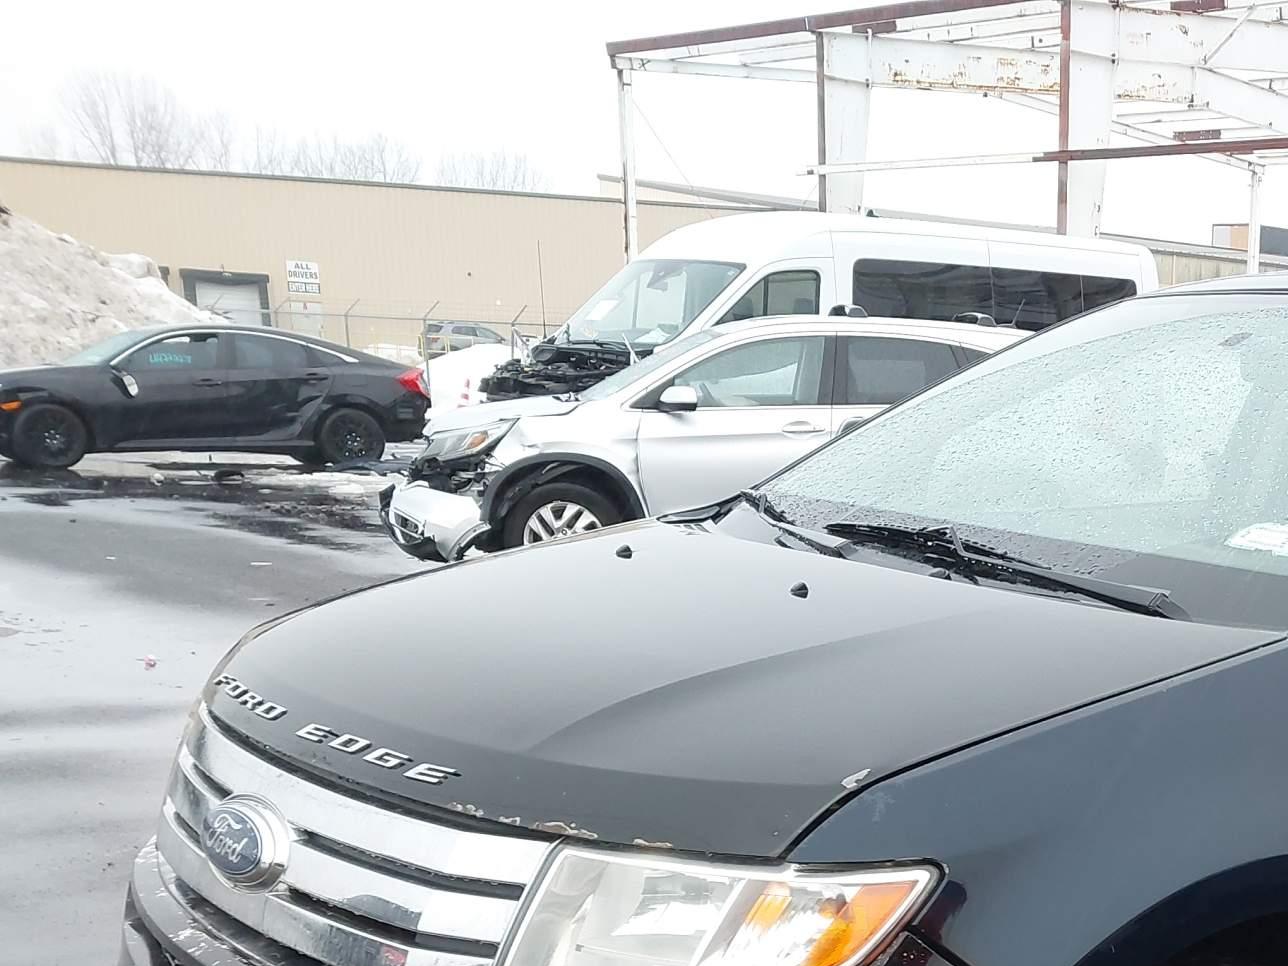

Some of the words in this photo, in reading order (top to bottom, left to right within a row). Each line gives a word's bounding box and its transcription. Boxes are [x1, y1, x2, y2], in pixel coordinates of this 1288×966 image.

[287, 270, 319, 280] DRIVERS
[294, 262, 312, 270] ALL
[213, 673, 288, 721] FORD
[295, 723, 462, 785] EDGE
[206, 813, 249, 864] Ford
